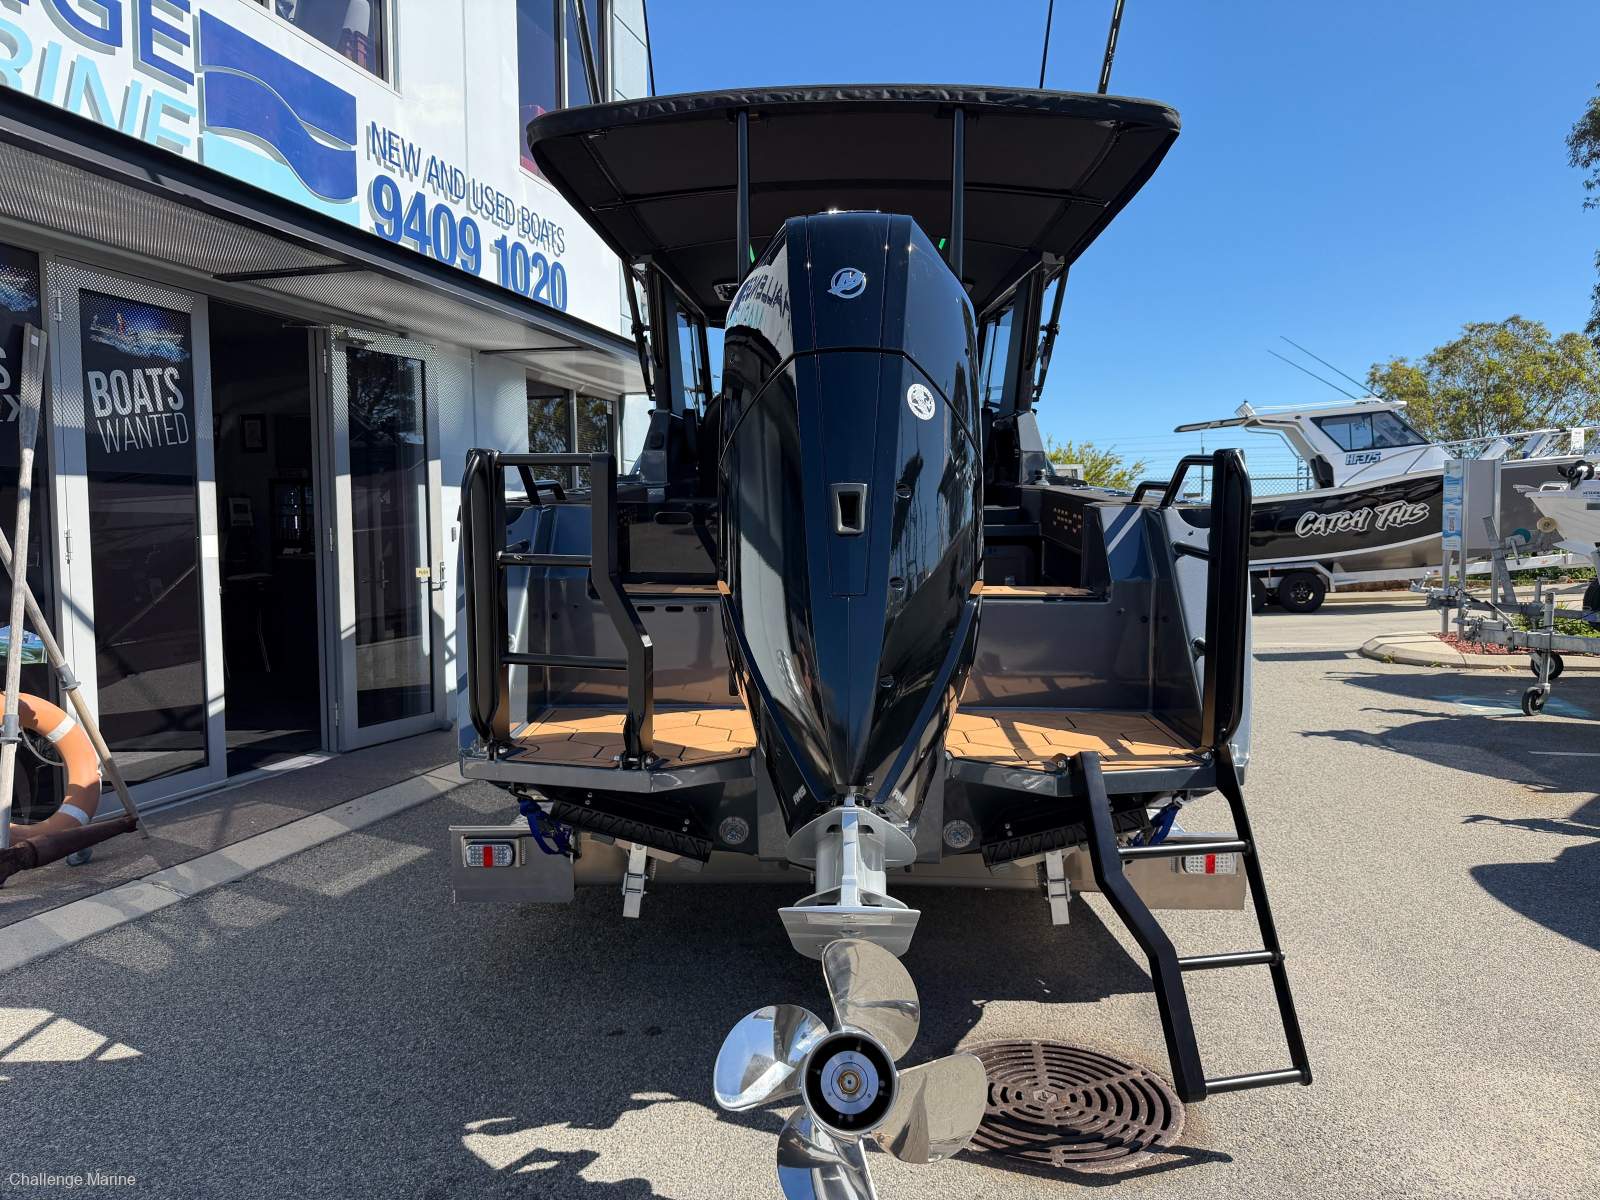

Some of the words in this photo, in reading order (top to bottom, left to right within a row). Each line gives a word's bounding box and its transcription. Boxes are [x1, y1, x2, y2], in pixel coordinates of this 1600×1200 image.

[371, 121, 421, 177] NEW
[427, 155, 466, 200] AND
[472, 178, 516, 226] USED
[521, 206, 565, 254] BOATS
[371, 174, 482, 278] 9409
[494, 234, 568, 313] 1020
[87, 366, 184, 418] BOATS
[97, 412, 189, 454] WANTED
[1345, 451, 1382, 465] HF375
[1295, 507, 1373, 538] CATCH
[1374, 500, 1430, 531] THIS
